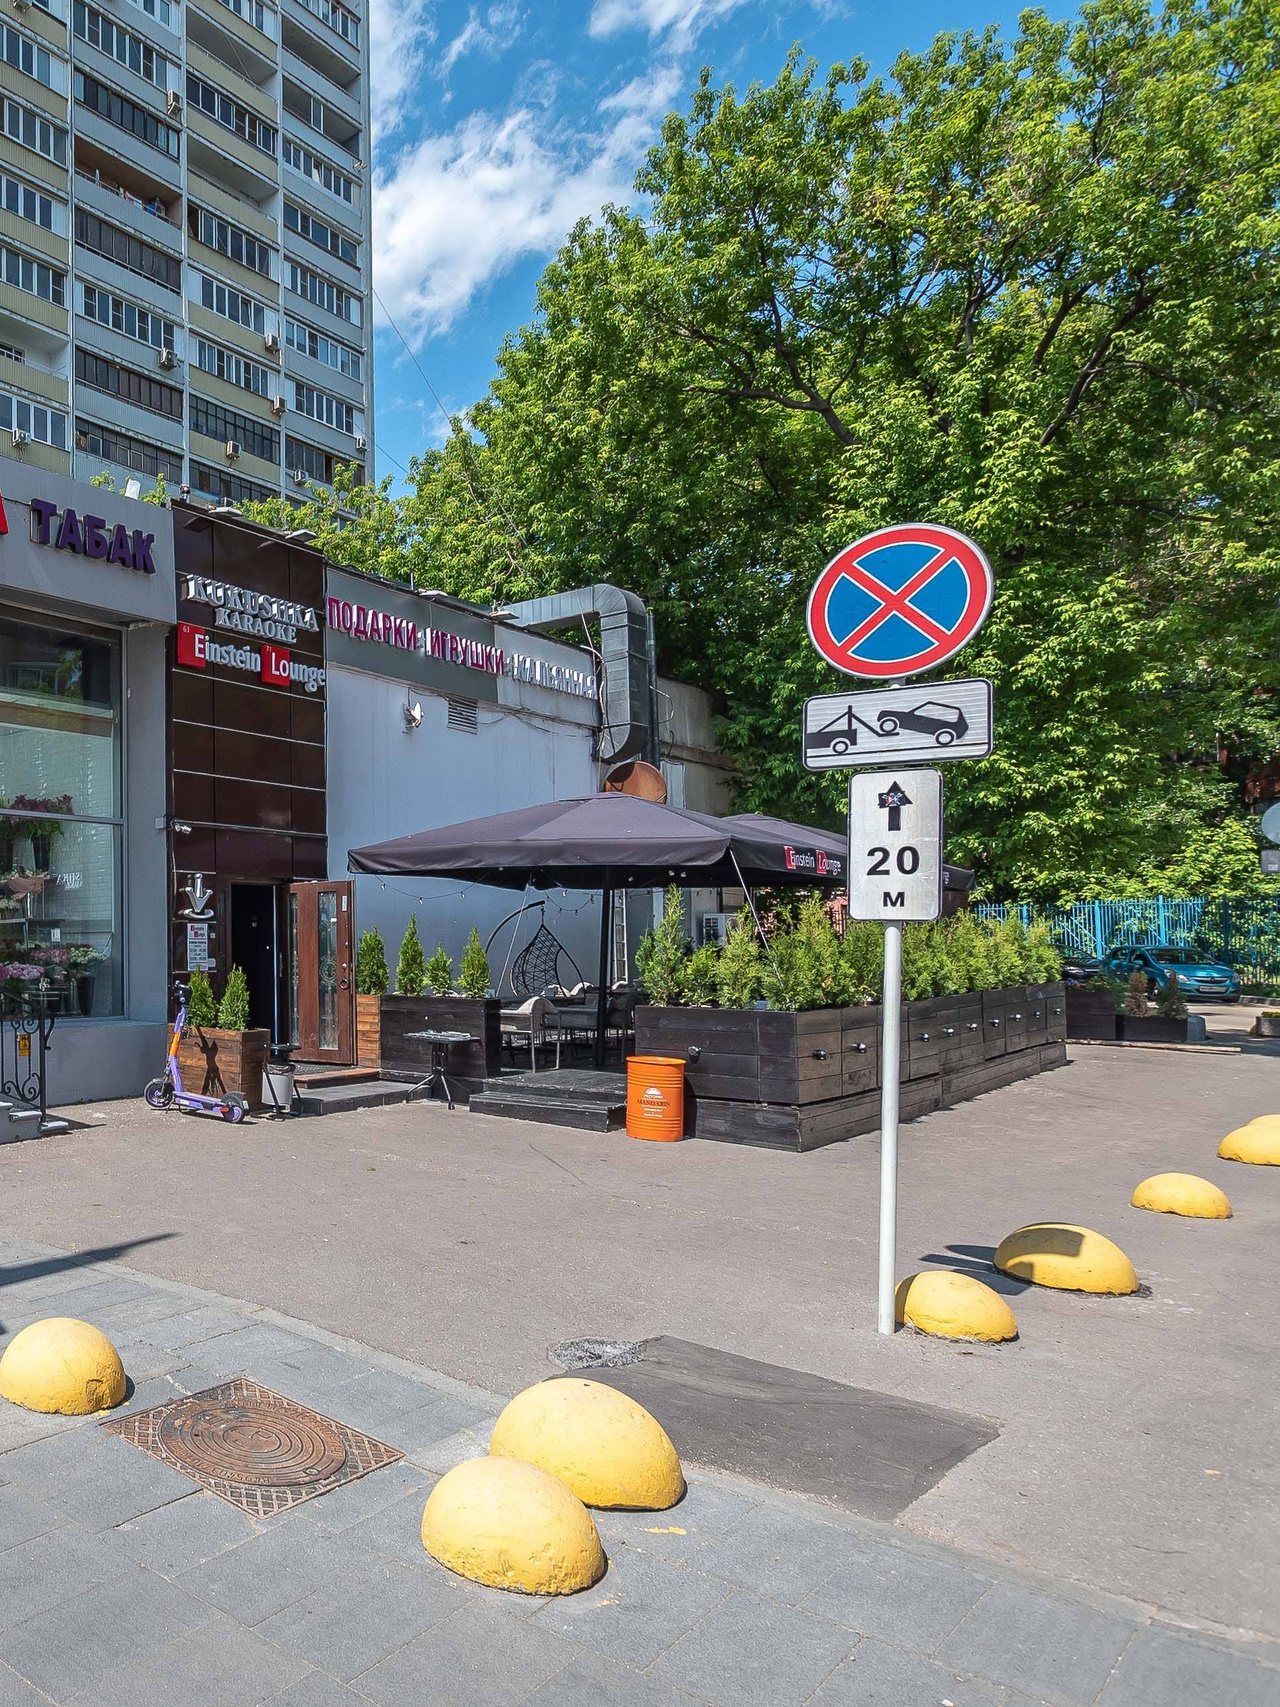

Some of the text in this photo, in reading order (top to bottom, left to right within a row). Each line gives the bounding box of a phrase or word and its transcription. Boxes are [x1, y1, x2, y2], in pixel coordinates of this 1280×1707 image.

[31, 497, 156, 574] ТАБАК
[185, 574, 319, 632] KUKUSHKA
[214, 607, 298, 644] KARAOKE
[194, 632, 325, 693] Einstein Lounge
[327, 596, 599, 700] ПОДАРКИ ИГРУШКИ КАЛЬЯННАЯ
[790, 850, 841, 876] Einstein Lounge
[866, 845, 920, 876] 20
